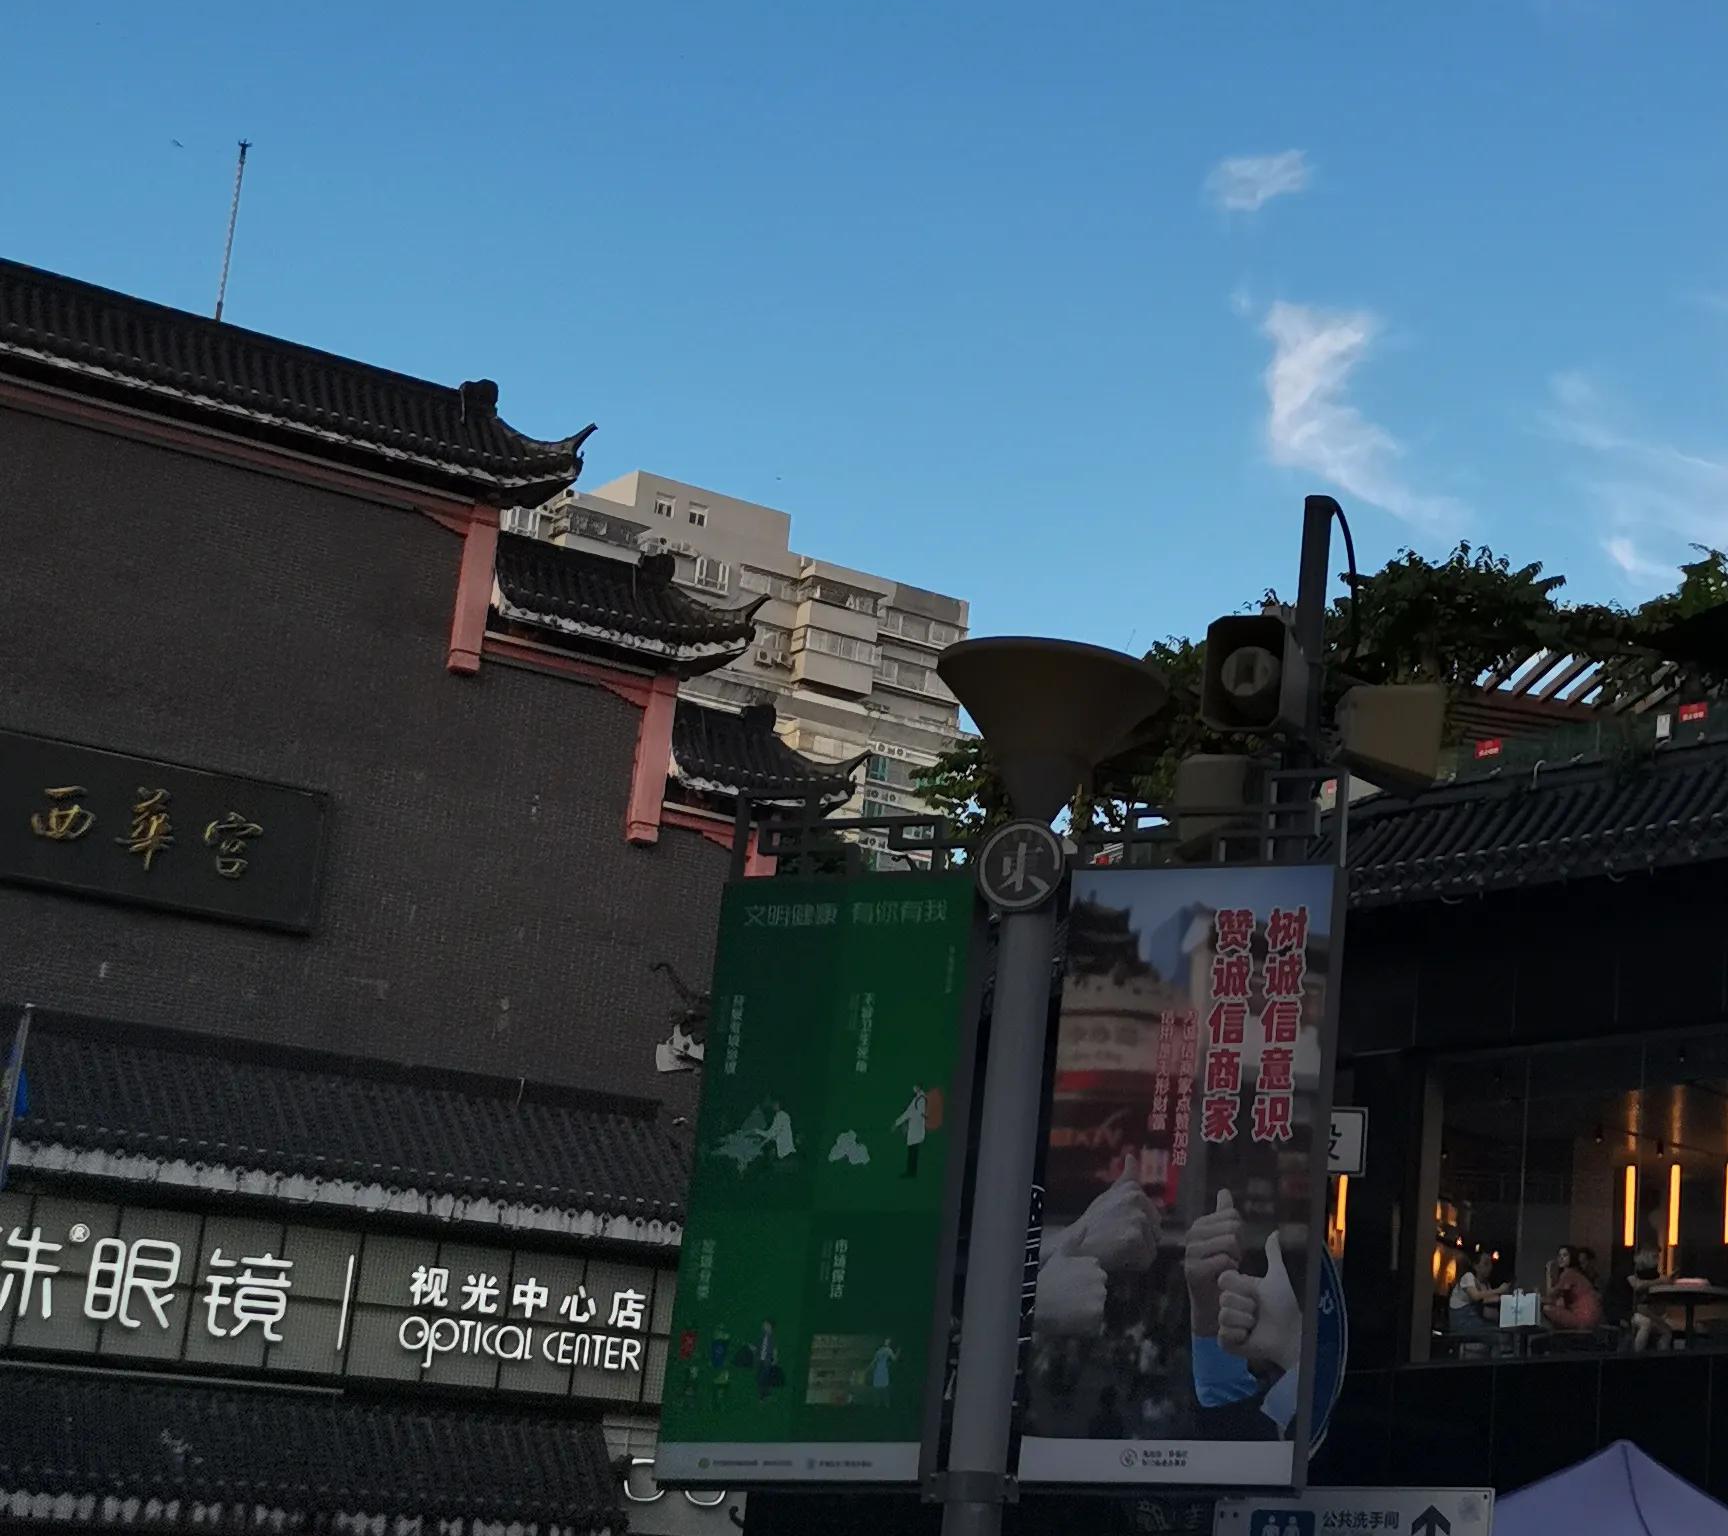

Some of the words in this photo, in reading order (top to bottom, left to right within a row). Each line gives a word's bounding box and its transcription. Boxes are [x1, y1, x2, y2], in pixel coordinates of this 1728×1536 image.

[743, 902, 840, 928] 文明健康
[851, 898, 949, 925] 有你有我
[1200, 908, 1255, 1144] 赞诚信商家
[1251, 906, 1309, 1144] 树诚信意识
[409, 1265, 647, 1331] 视光中心店
[1322, 1511, 1400, 1530] 公共洗手间
